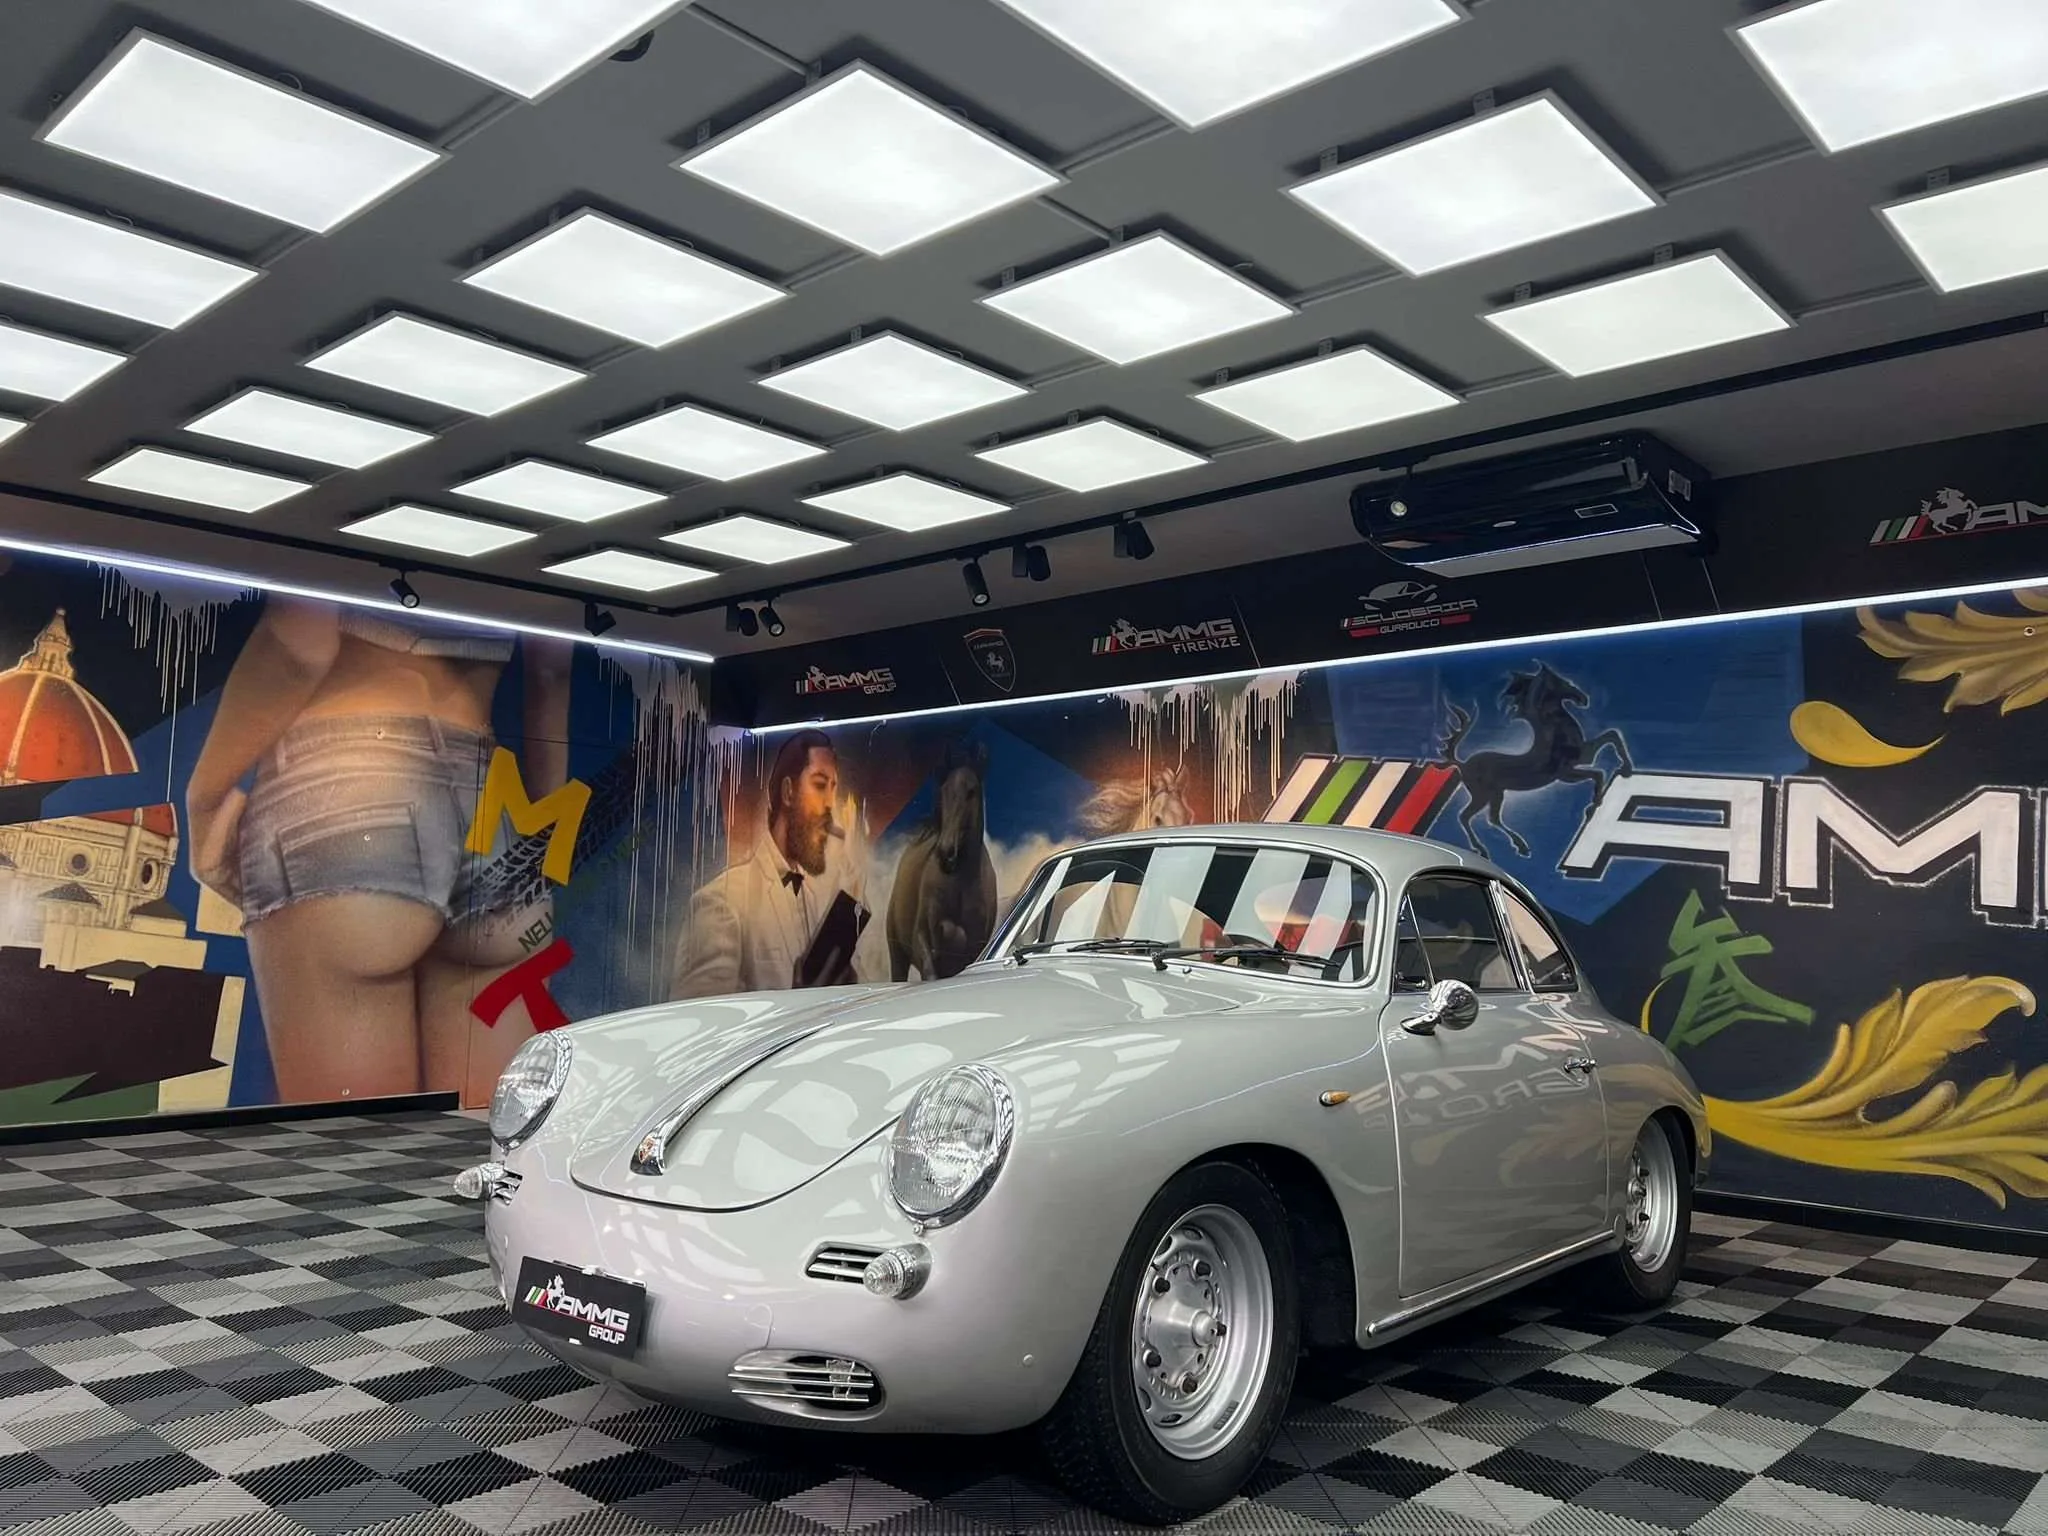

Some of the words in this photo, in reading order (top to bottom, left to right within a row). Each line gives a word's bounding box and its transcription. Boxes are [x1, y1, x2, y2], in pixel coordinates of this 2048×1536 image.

[1351, 598, 1479, 626] SCUDERIA
[1134, 617, 1233, 648] AMMG
[1172, 635, 1241, 655] FIRENZE
[825, 667, 895, 690] AMMG
[863, 681, 897, 695] GROUP
[1556, 770, 2048, 928] AM
[554, 1294, 630, 1333] AMMG
[588, 1323, 626, 1345] GROUP
